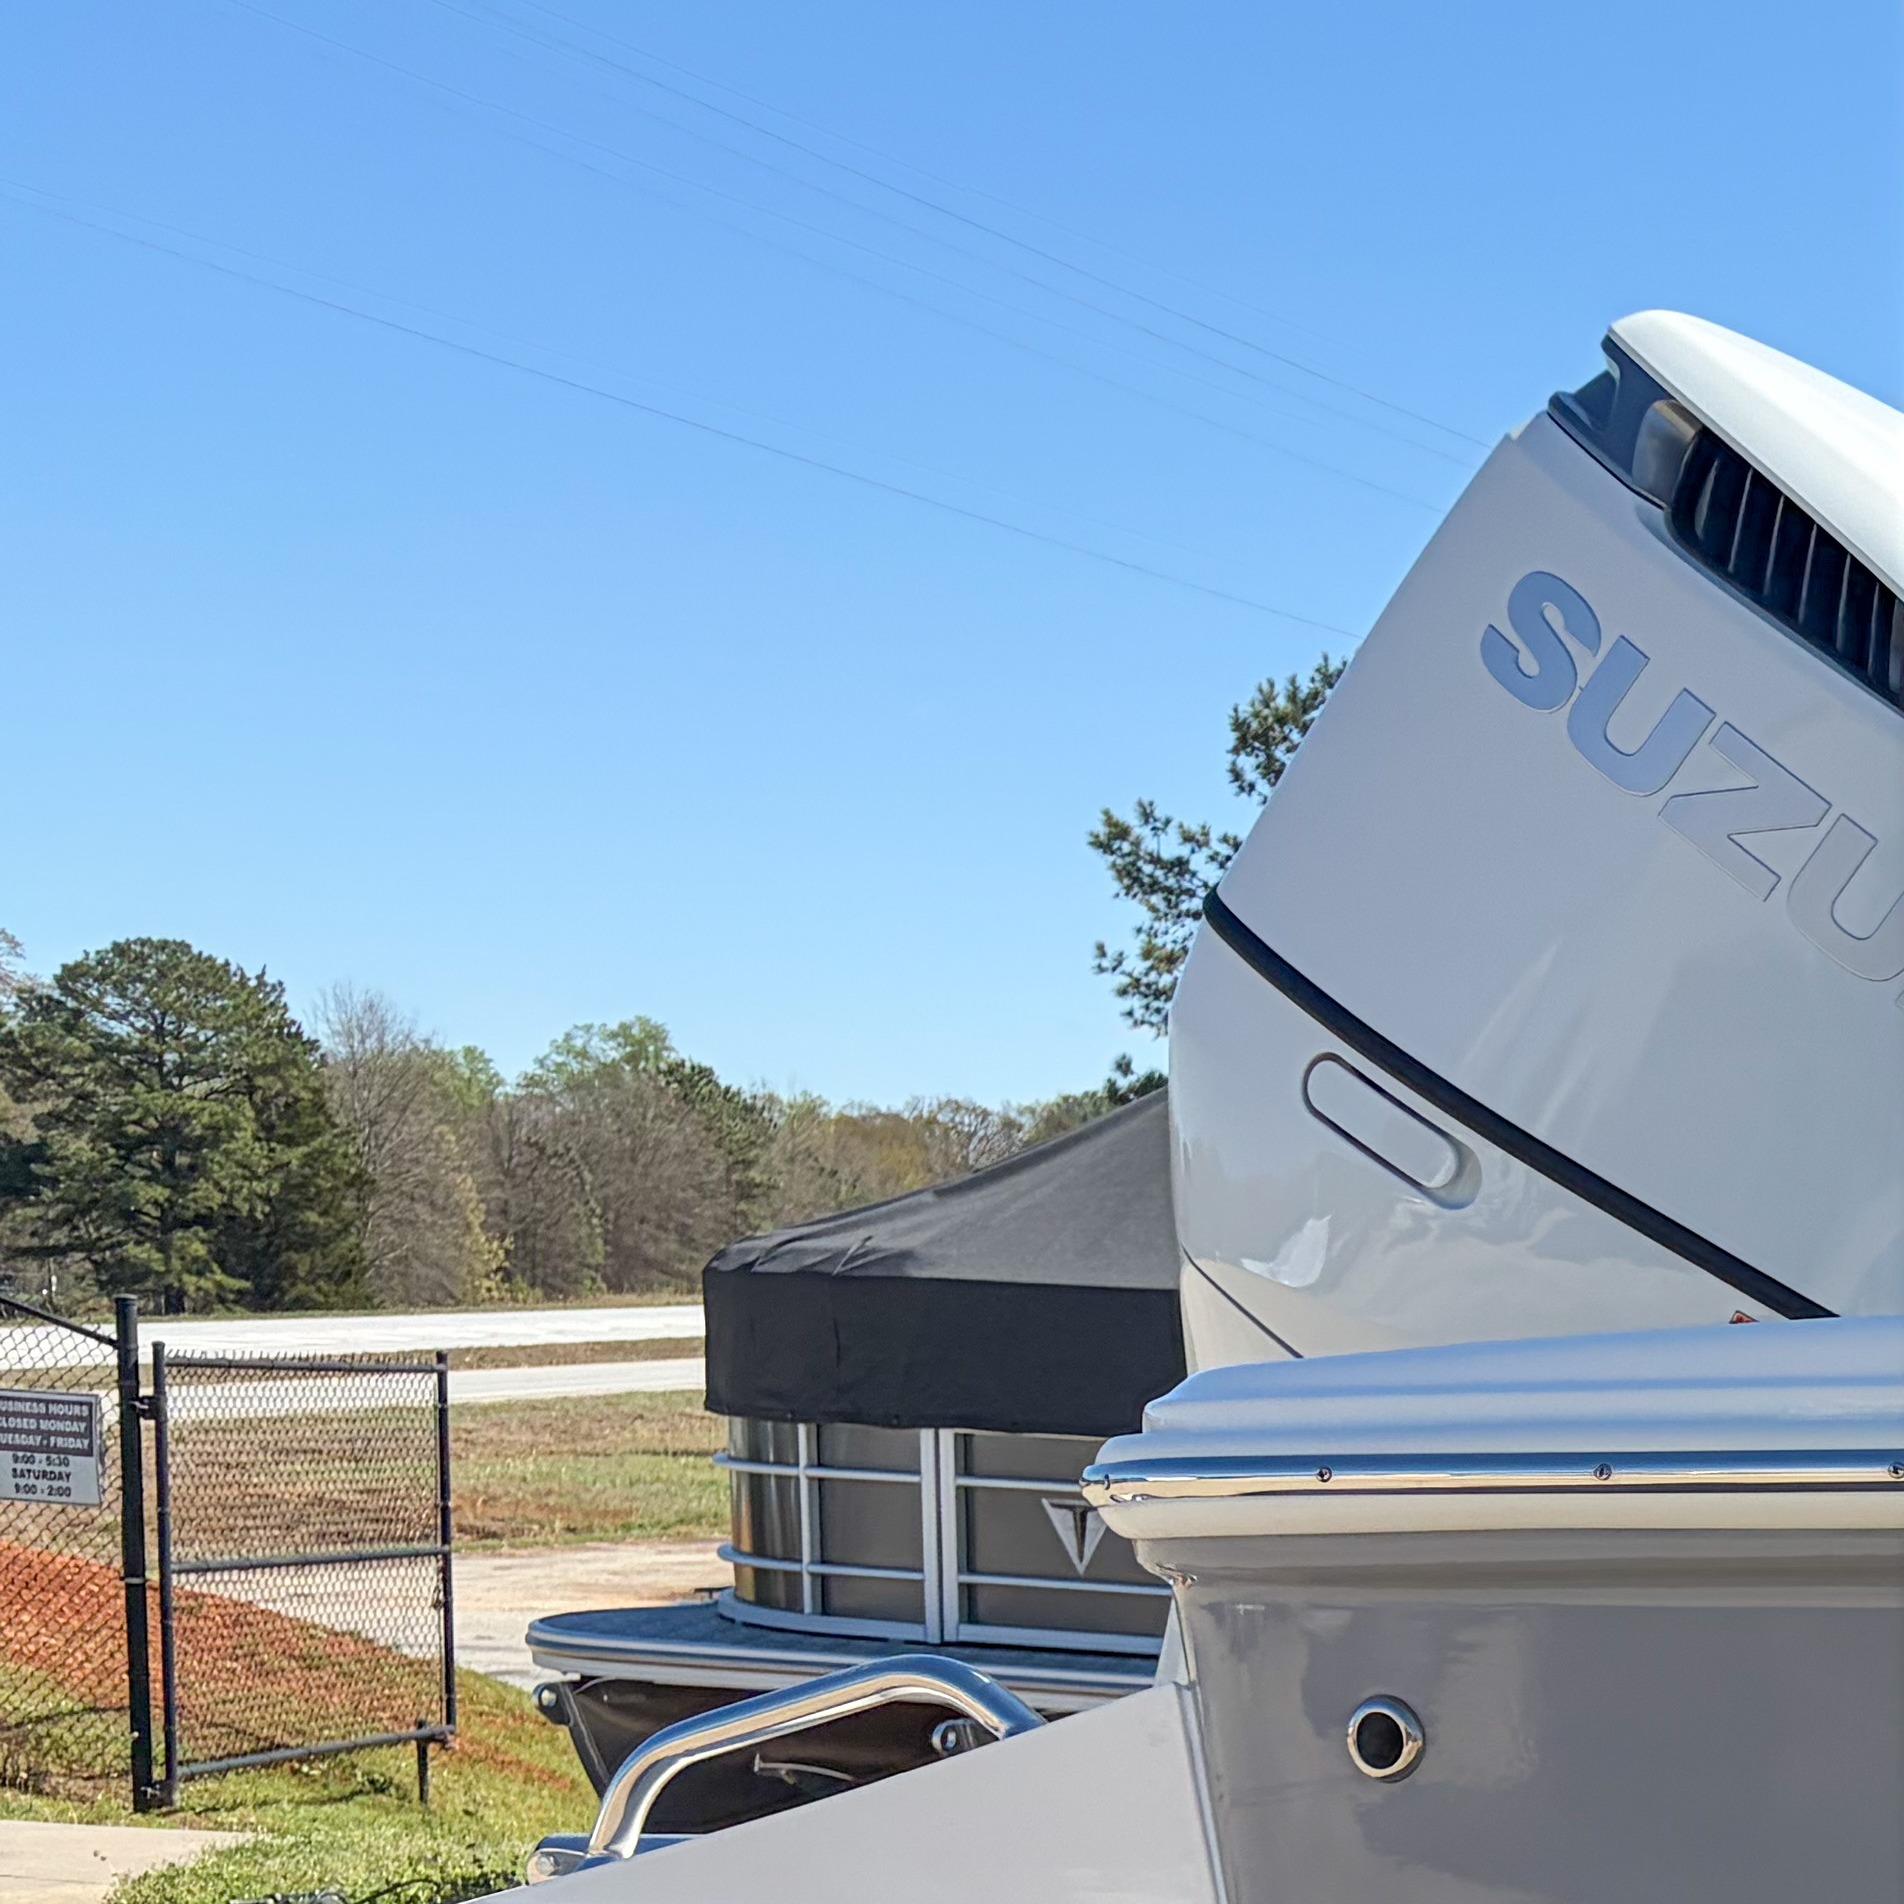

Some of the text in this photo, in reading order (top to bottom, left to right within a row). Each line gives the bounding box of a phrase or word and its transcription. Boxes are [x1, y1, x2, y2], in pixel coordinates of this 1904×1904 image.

[0, 1400, 89, 1417] USINESS HOURS
[40, 1419, 87, 1433] MONDAY
[50, 1436, 90, 1450] FRIDAY
[11, 1468, 71, 1482] SATURDAY
[47, 1485, 72, 1498] 2:00
